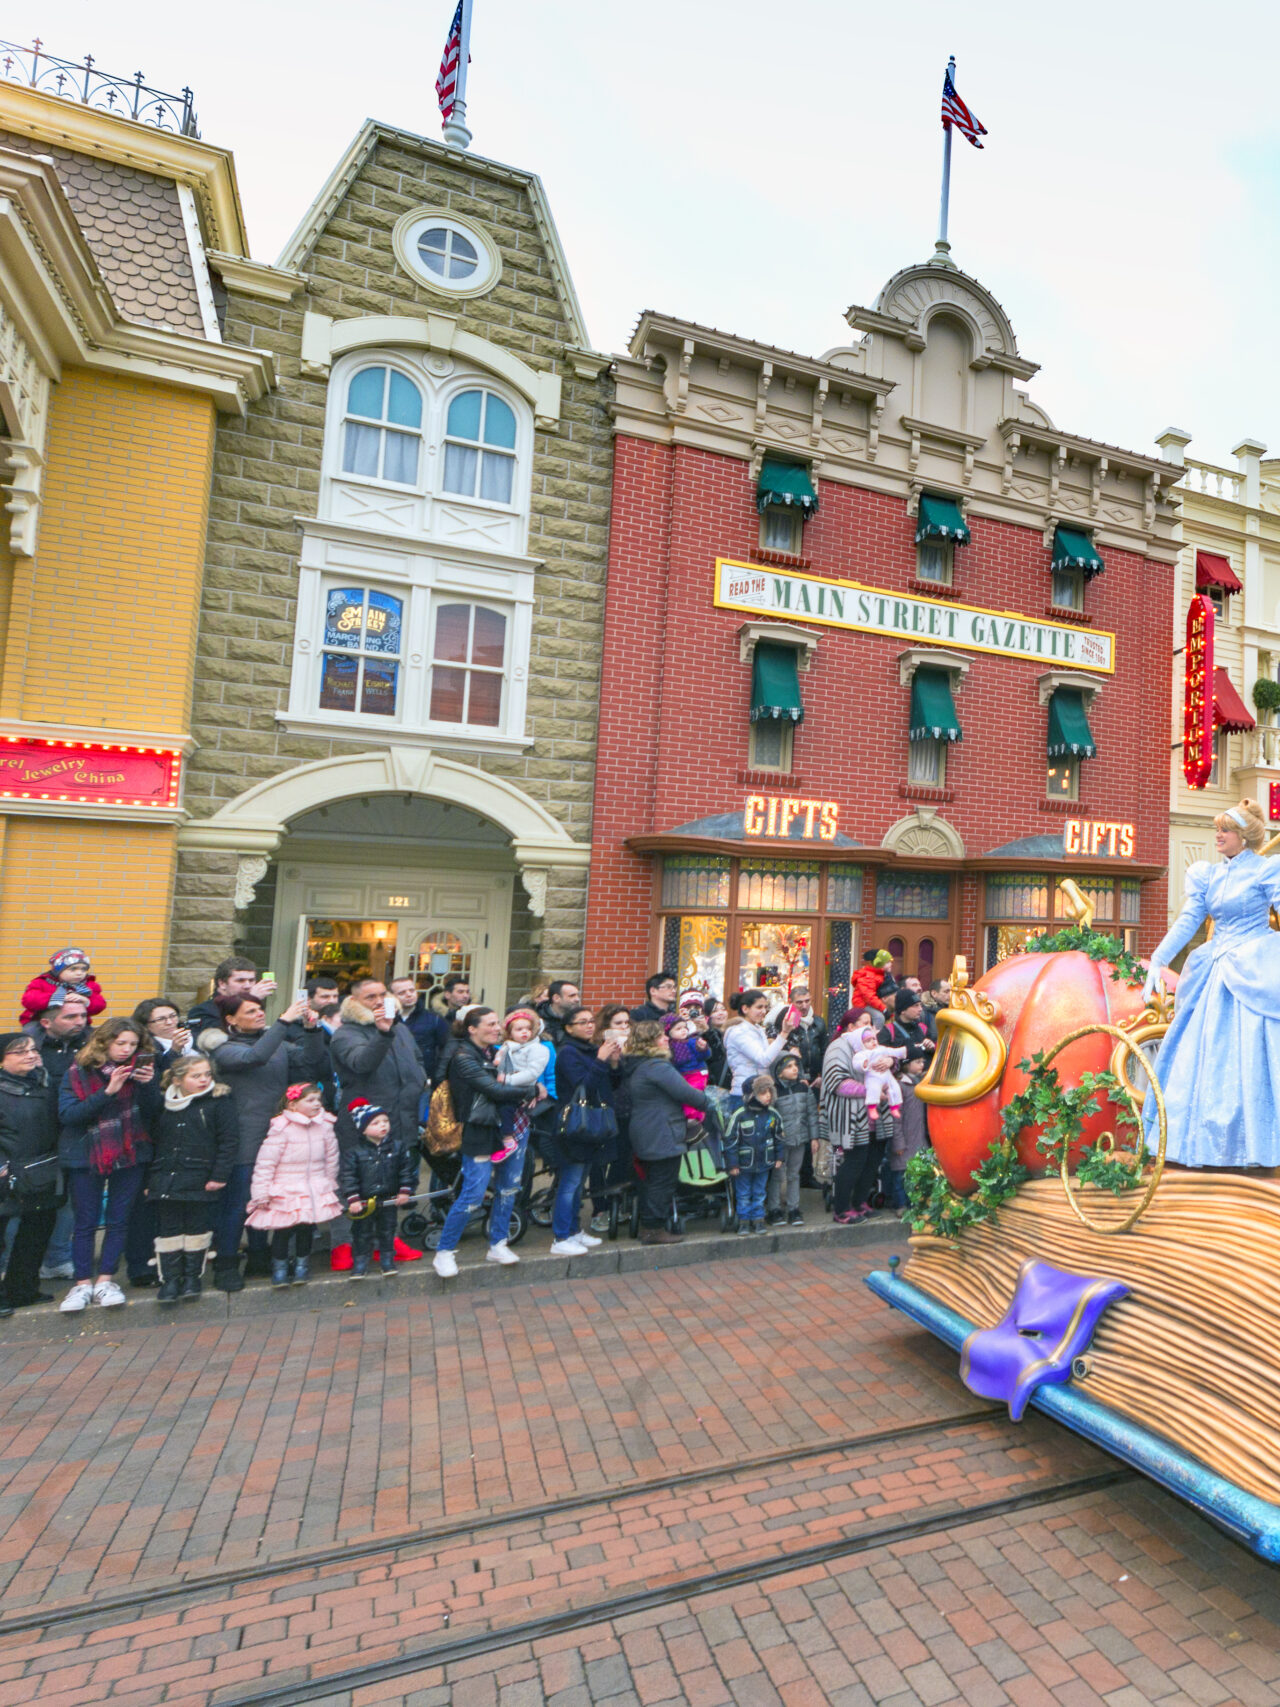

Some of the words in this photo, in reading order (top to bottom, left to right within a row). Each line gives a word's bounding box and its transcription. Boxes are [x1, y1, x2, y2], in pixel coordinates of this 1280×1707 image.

[729, 580, 749, 597] READ
[751, 577, 766, 593] THE
[345, 605, 387, 622] MAIN
[771, 578, 847, 619] MAIN
[857, 592, 960, 638] STREET
[971, 615, 1076, 659] GAZETTE
[327, 631, 382, 645] MARCHING
[347, 641, 379, 651] BAND
[1084, 636, 1104, 655] TRUSTED
[1081, 644, 1095, 659] SINCE
[1188, 617, 1202, 763] EMPORIUM
[21, 759, 86, 781] Jewelry
[74, 771, 126, 784] China
[745, 795, 839, 840] GIFTS
[1064, 819, 1134, 858] GIFTS
[388, 896, 409, 907] 121
